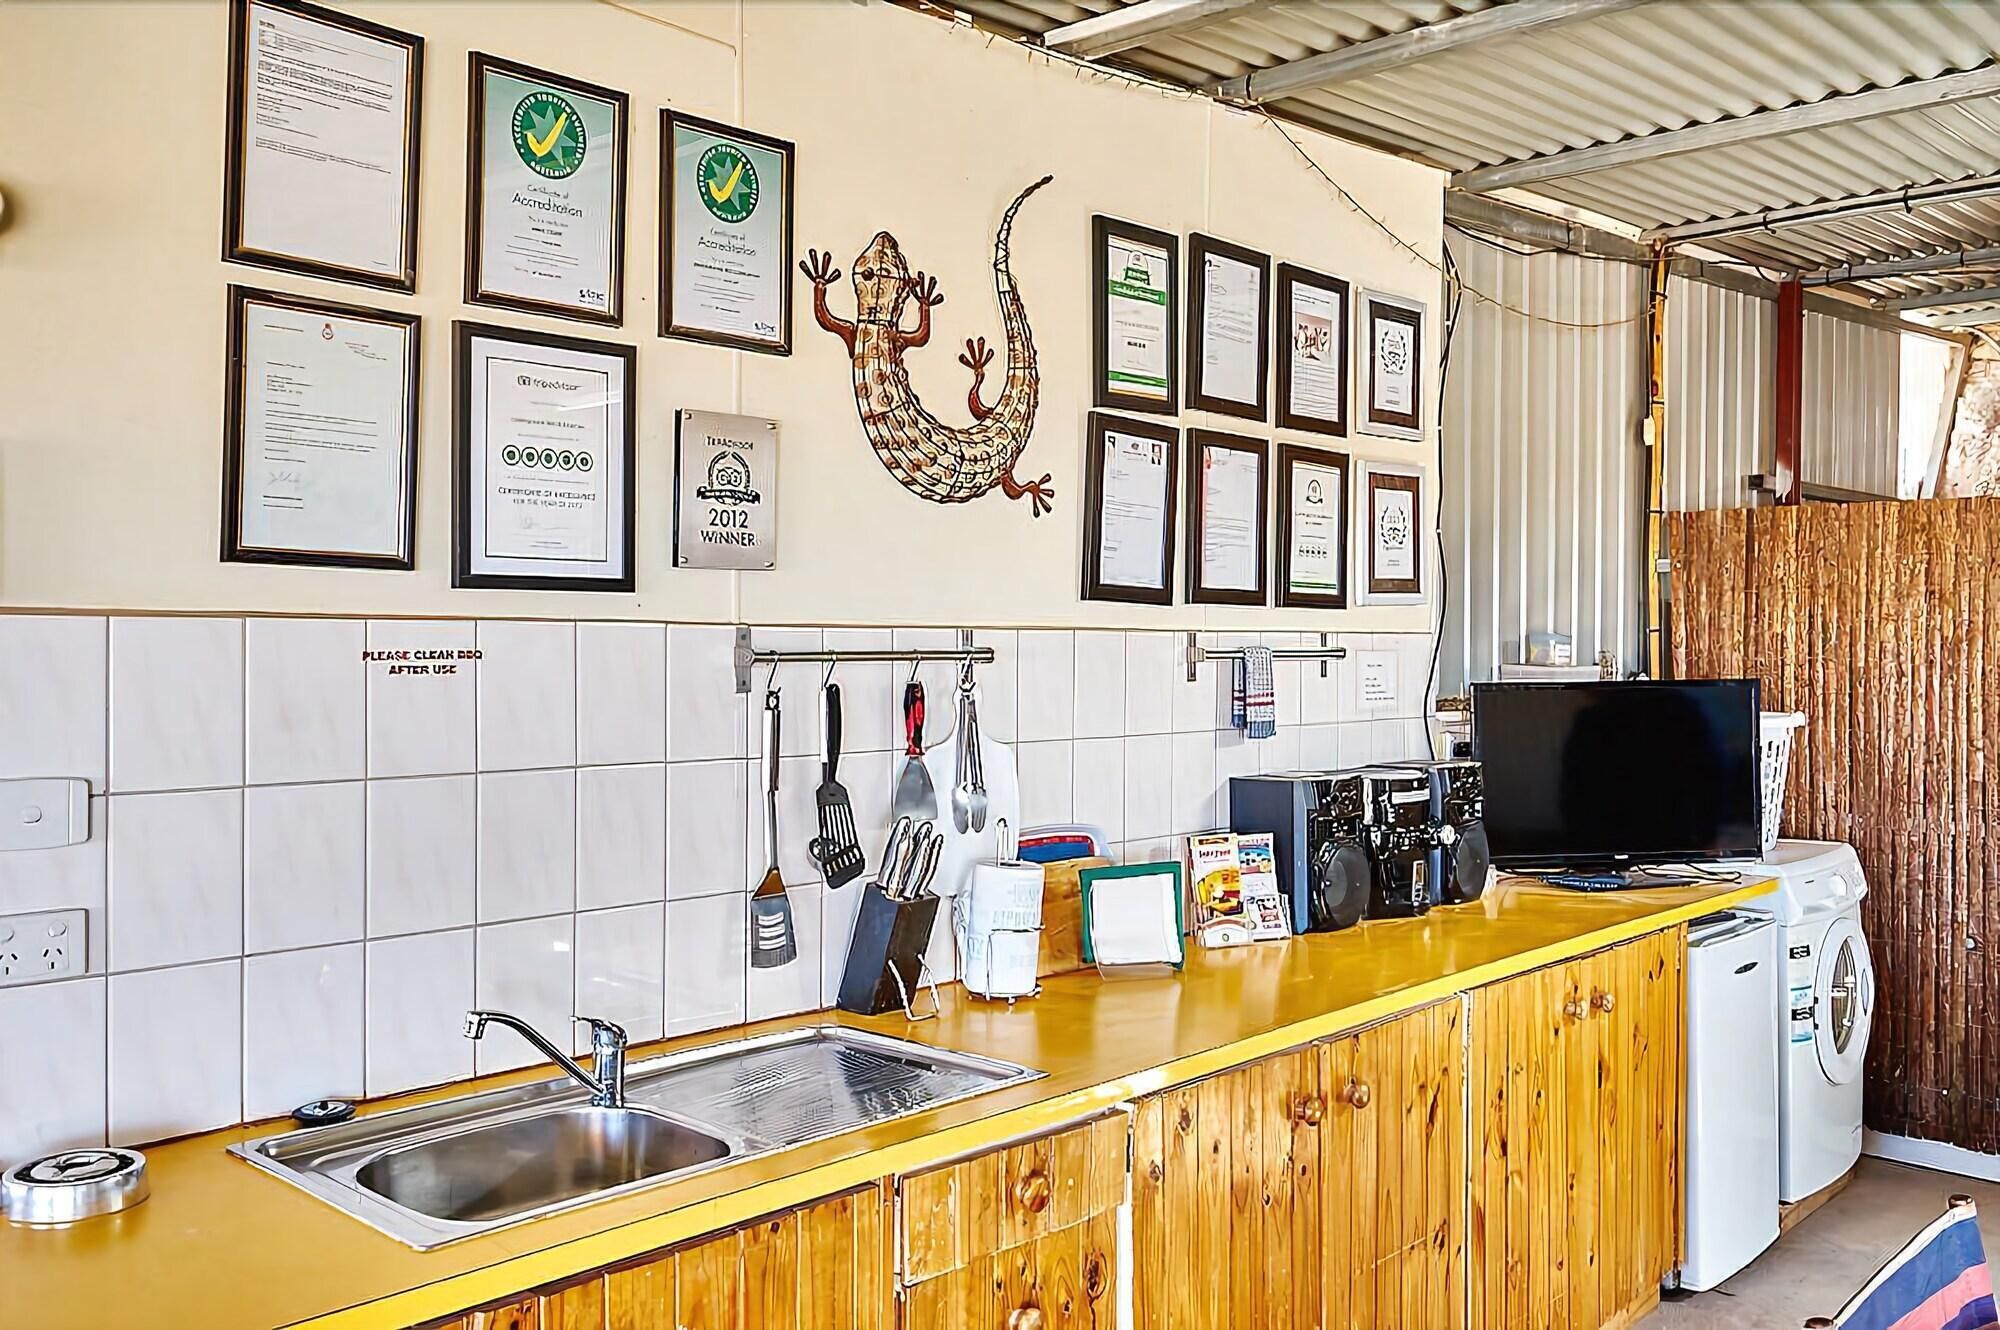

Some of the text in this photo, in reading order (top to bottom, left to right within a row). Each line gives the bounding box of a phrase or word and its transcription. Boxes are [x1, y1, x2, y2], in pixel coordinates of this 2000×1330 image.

[709, 508, 748, 528] 2012
[700, 529, 755, 547] WINNER
[362, 649, 484, 661] PLEASE CLEAN BBQ
[388, 665, 458, 675] AFTER USE
